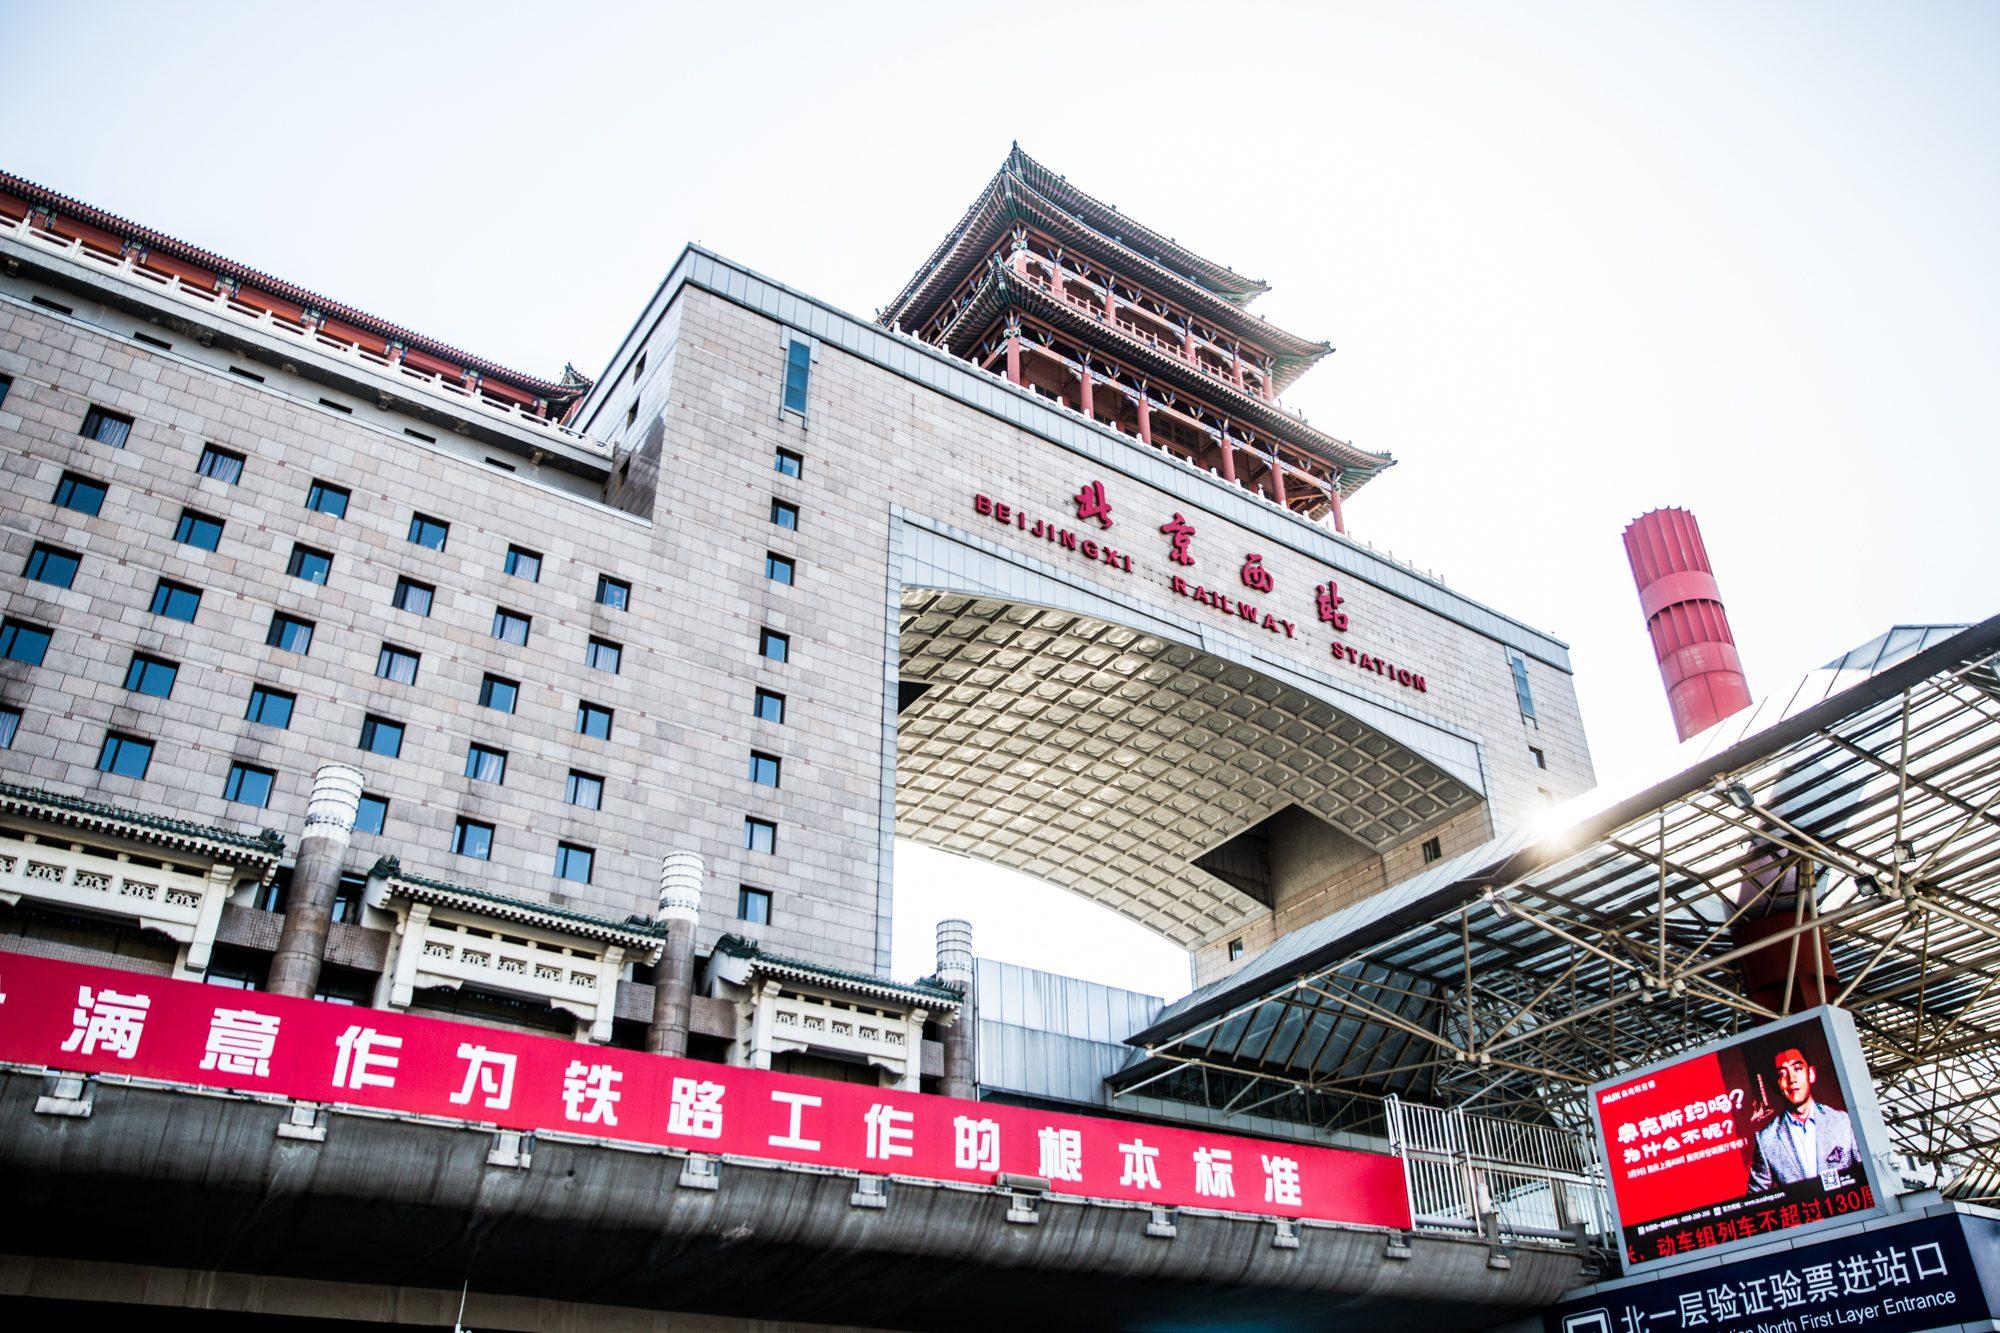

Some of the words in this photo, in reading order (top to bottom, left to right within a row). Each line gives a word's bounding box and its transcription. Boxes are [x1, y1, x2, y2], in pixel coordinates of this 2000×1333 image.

[976, 494, 1131, 573] BEIJINGXI
[1173, 575, 1297, 638] RAILWAY
[1332, 641, 1427, 692] STATION
[1076, 481, 1348, 631] 北京西站
[0, 985, 1302, 1206] 满意作为铁路工作的根本标准
[1621, 1242, 1949, 1333] 北一层验证验票进站口
[1757, 1318, 1797, 1333] North
[1800, 1312, 1833, 1330] First
[1836, 1303, 1879, 1325] Layer
[1884, 1290, 1957, 1315] Entrance
